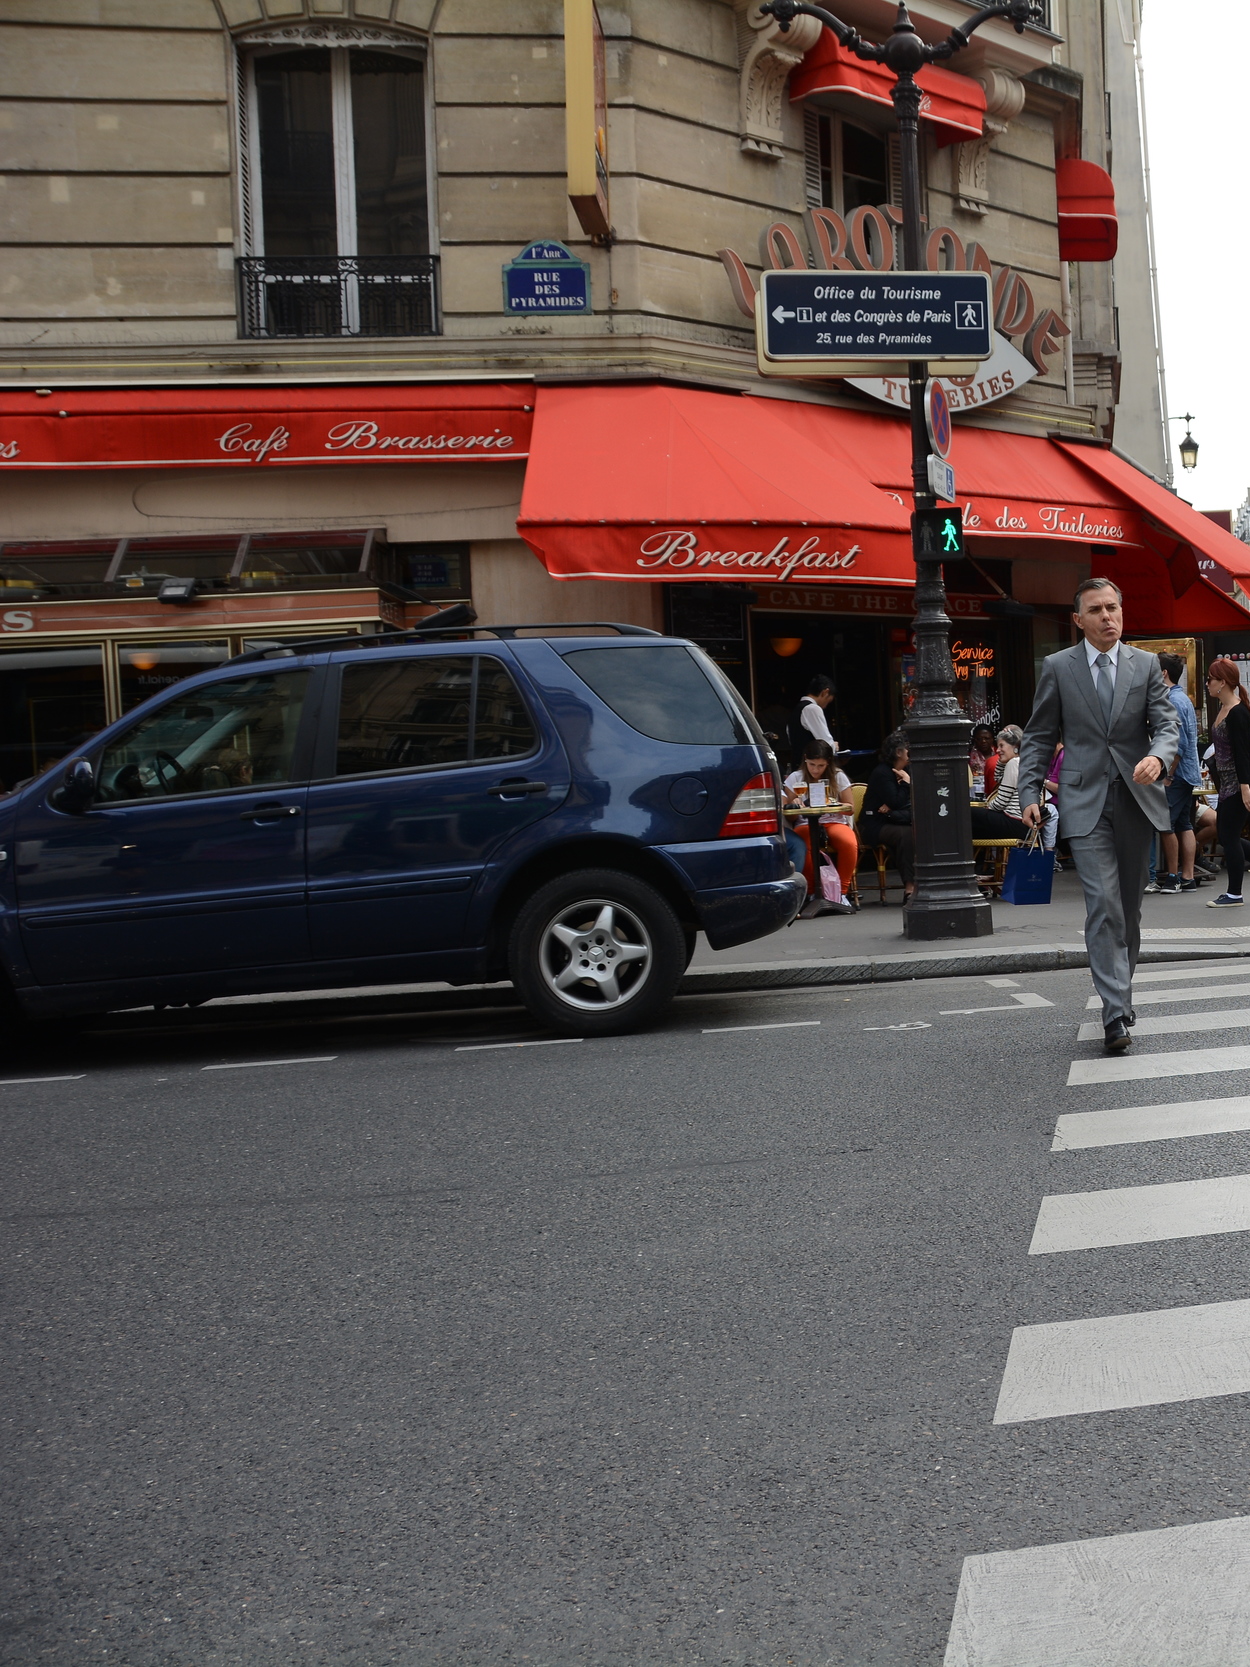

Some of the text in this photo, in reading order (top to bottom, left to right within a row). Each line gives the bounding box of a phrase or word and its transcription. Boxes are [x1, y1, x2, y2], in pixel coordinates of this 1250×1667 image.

[533, 272, 560, 282] RUE
[535, 284, 560, 294] DES
[813, 286, 942, 300] Office du Tourisme
[511, 296, 584, 307] PYRAMIDES
[814, 312, 827, 322] et
[830, 310, 851, 323] des
[854, 309, 903, 326] Congrès
[906, 310, 921, 323] de
[923, 309, 952, 323] Paris
[816, 332, 932, 347] 25, rue des Pyramides
[882, 369, 1016, 408] TUERIES
[214, 420, 514, 463] Café Brasserie
[995, 506, 1027, 529] des
[1039, 507, 1124, 538] Tuileries
[636, 530, 863, 580] Breakfast
[769, 590, 981, 613] CAFE THE GACE
[951, 640, 994, 662] Service
